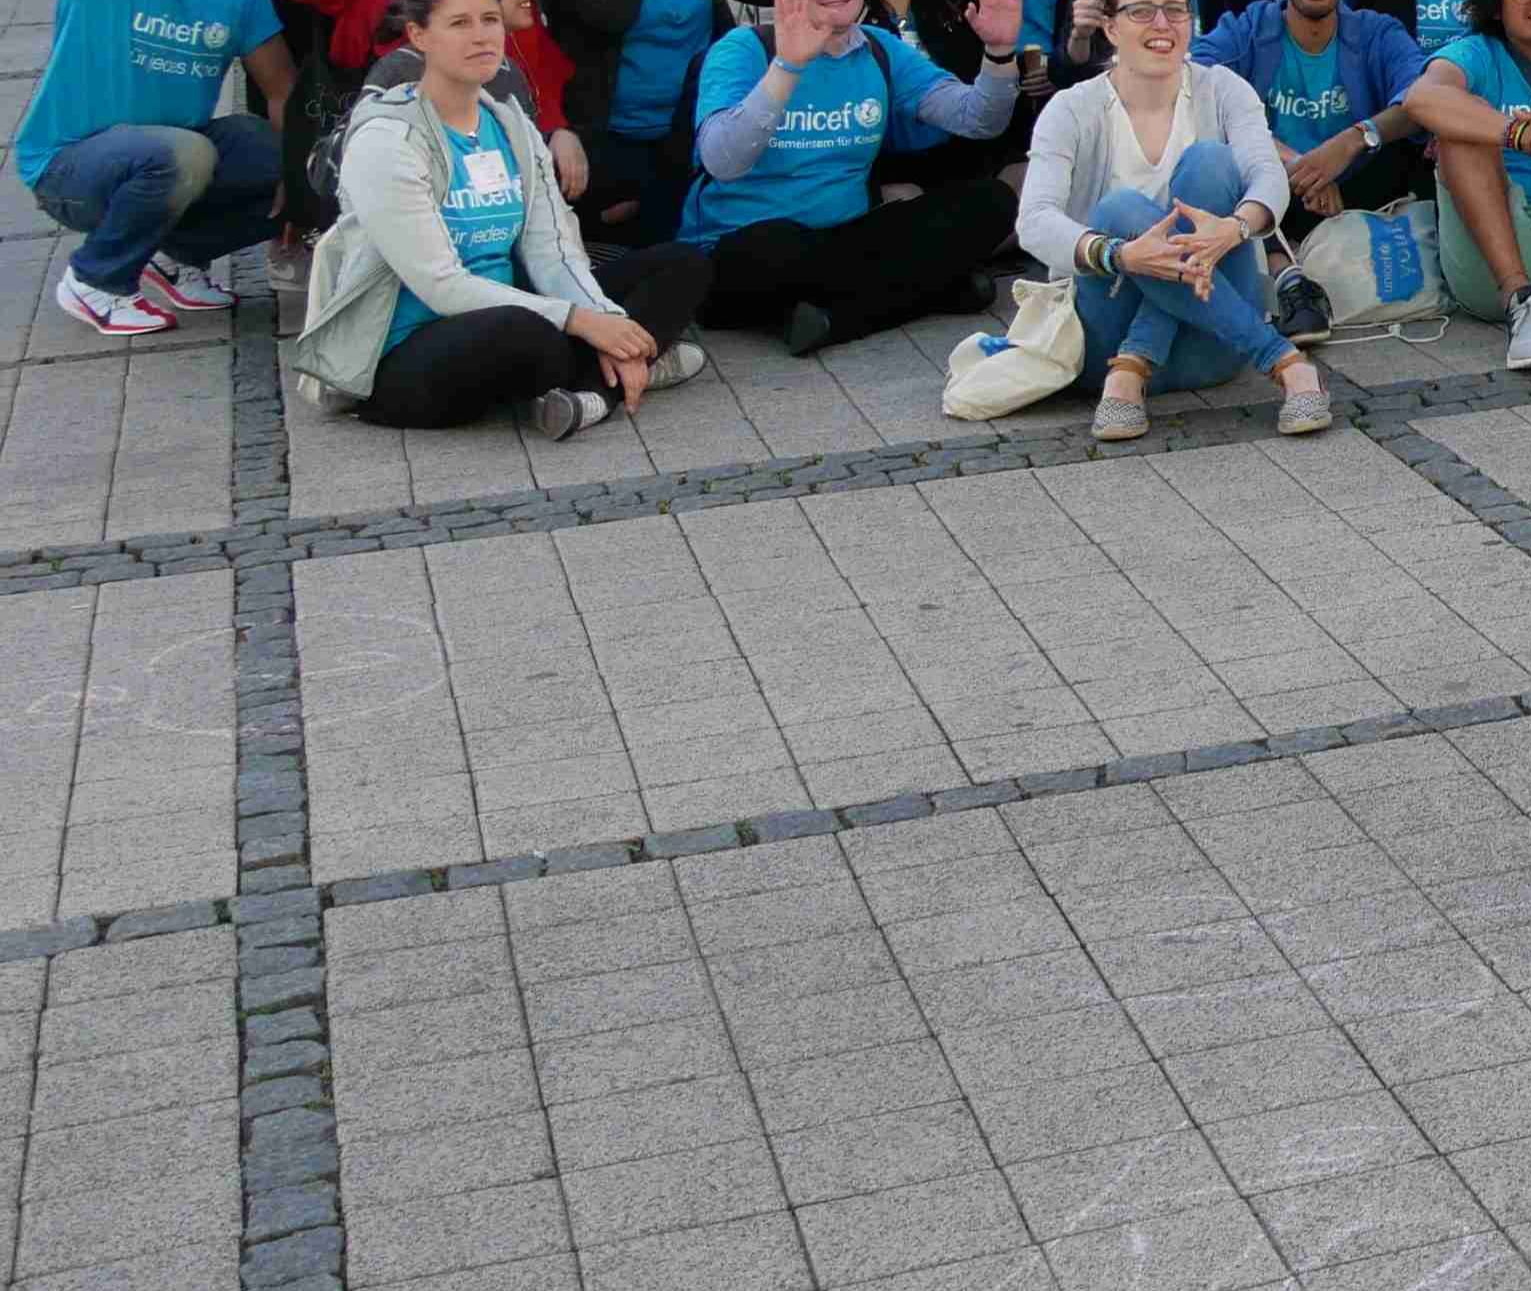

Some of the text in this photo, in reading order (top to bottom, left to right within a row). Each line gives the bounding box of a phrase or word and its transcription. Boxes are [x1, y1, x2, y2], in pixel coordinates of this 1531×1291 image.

[132, 11, 203, 46] unicef
[836, 134, 852, 148] für
[469, 227, 503, 249] jedes
